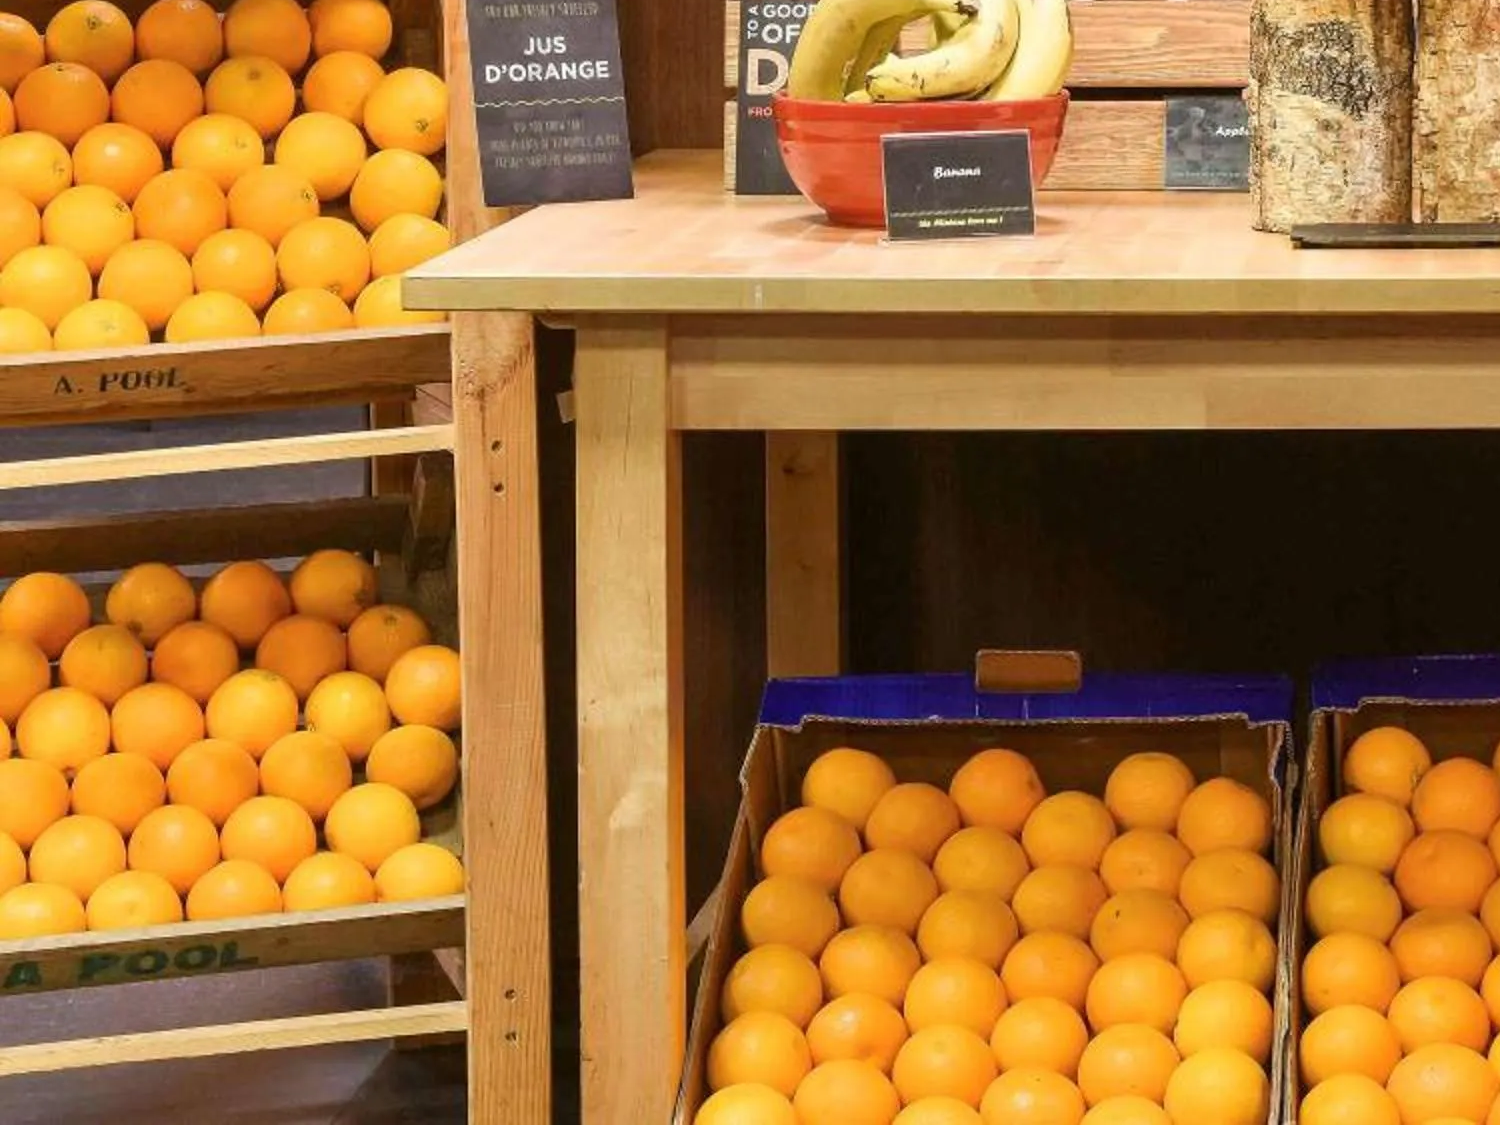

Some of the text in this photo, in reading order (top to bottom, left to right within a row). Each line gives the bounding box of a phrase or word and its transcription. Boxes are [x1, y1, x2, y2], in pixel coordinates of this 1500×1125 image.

[747, 19, 759, 40] TO
[761, 23, 801, 44] OF
[523, 36, 567, 56] JUS
[485, 60, 609, 84] D'ORANGE
[748, 107, 773, 116] FRO
[933, 166, 981, 180] Banana
[54, 366, 195, 395] A. POOL
[3, 939, 259, 990] A POOL
